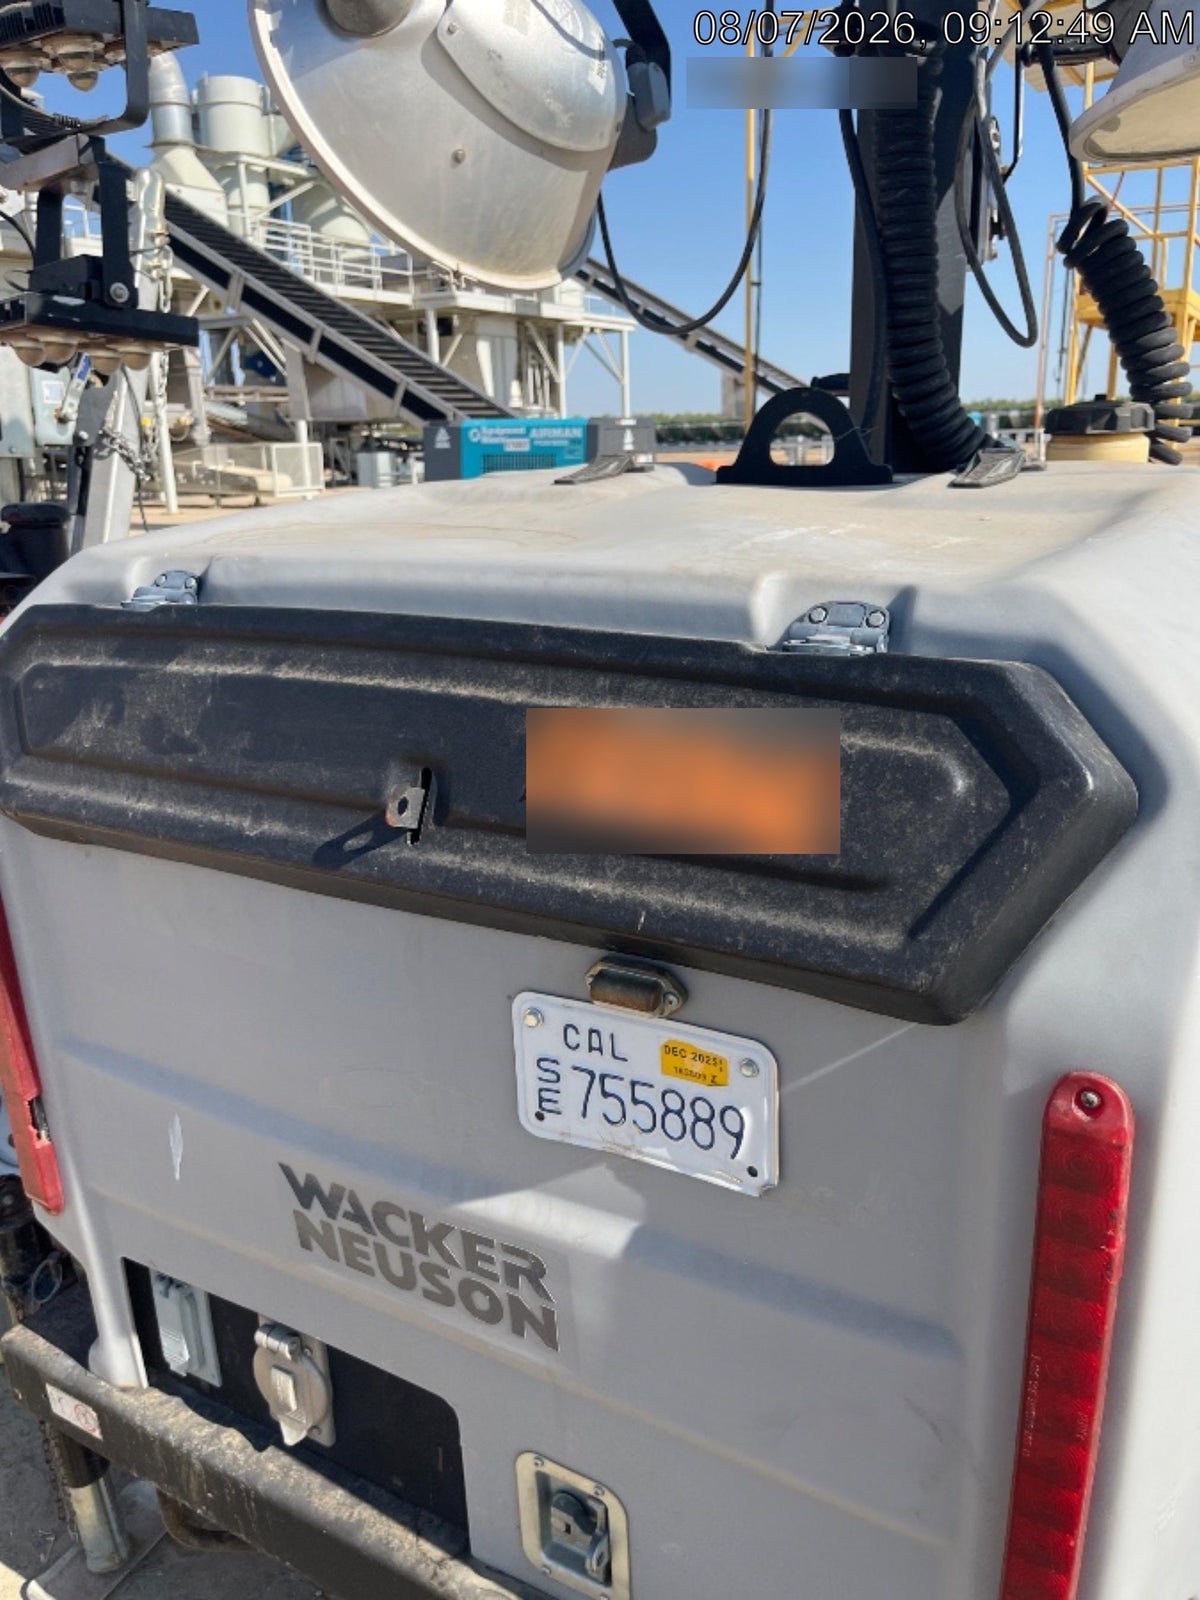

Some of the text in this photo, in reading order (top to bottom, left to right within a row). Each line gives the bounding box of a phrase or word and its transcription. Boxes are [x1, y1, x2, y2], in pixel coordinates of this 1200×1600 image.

[563, 1023, 628, 1062] CAL
[664, 1045, 687, 1059] DEC
[571, 1064, 745, 1160] 755889
[278, 1161, 557, 1304] WACKER
[293, 1209, 560, 1352] NEUSON
